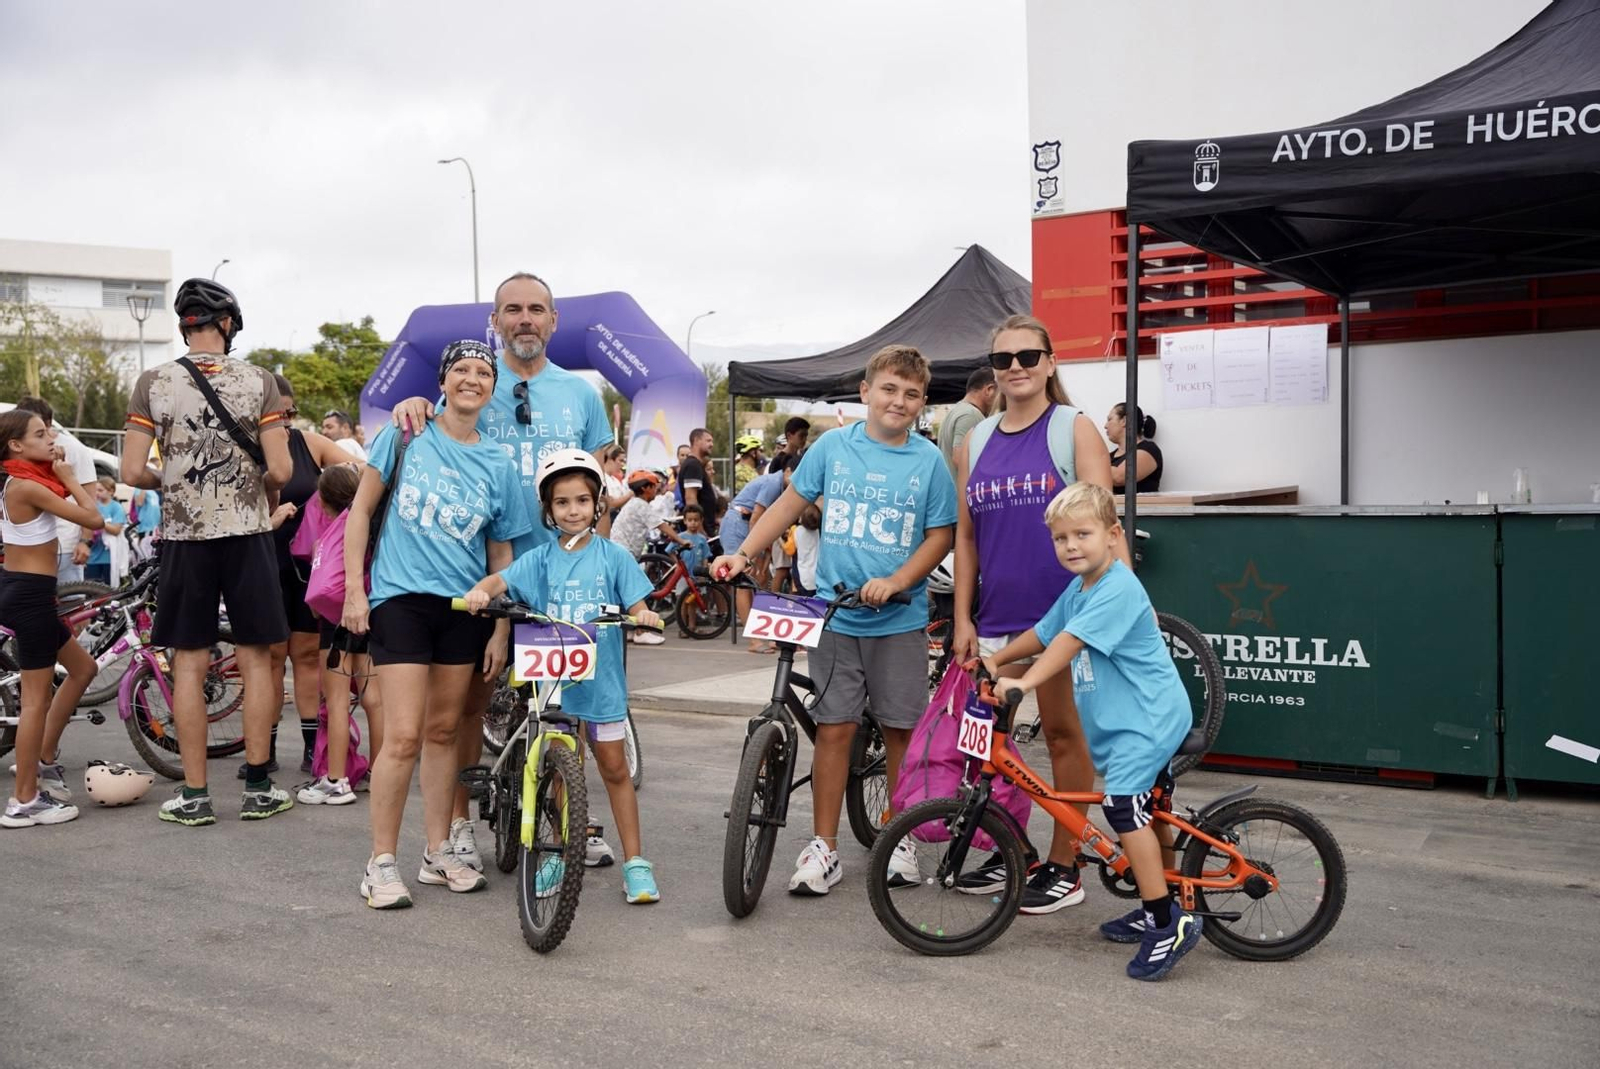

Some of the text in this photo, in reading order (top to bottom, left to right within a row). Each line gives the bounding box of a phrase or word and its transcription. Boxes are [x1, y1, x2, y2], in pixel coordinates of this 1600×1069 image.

[1272, 128, 1373, 162] AYTO.
[1386, 120, 1435, 153] DE
[598, 341, 608, 353] DE
[612, 339, 624, 350] DE
[1176, 381, 1212, 392] TICKETS
[487, 422, 575, 440] DÍA DE LA
[405, 465, 430, 487] DÍA
[436, 479, 460, 499] DE
[465, 491, 485, 512] LA
[830, 479, 915, 509] DÍA DE LA
[398, 482, 484, 547] BICI
[825, 498, 916, 547] BICI
[565, 591, 584, 601] DE
[588, 589, 606, 601] LA
[751, 615, 816, 641] 207
[524, 649, 589, 677] 209
[1224, 665, 1316, 684] LEVANTE
[1270, 695, 1305, 706] 1963
[960, 718, 988, 755] 208
